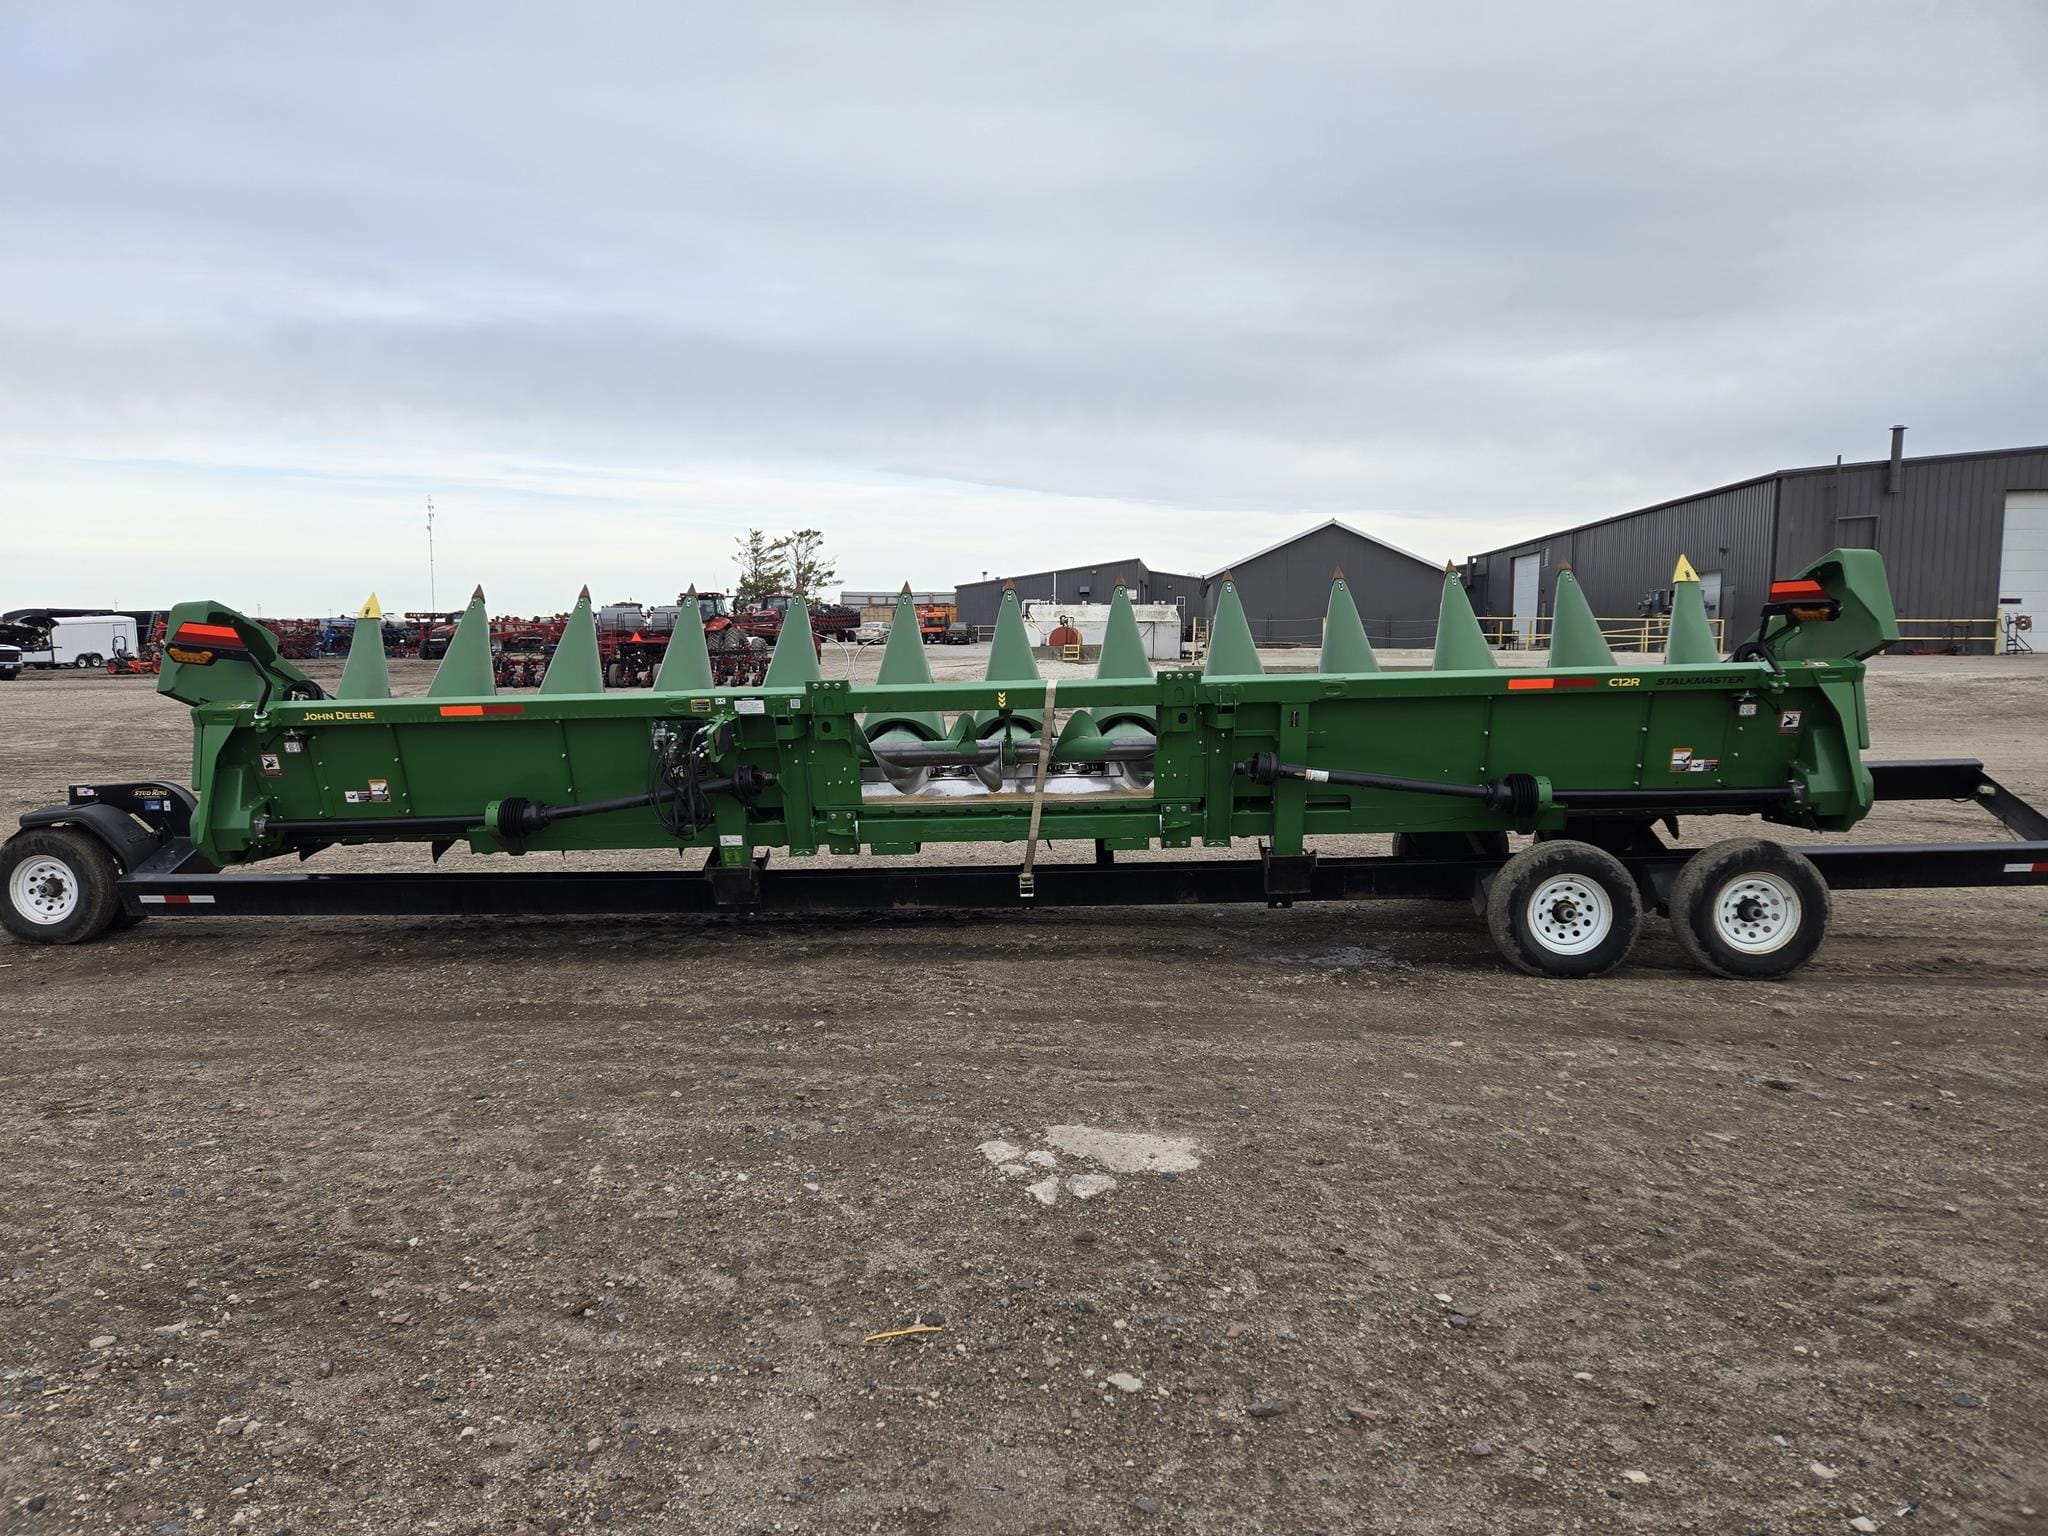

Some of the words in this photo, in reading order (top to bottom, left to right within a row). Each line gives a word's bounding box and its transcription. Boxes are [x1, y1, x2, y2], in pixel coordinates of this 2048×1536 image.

[1608, 678, 1641, 687] C12R
[1656, 676, 1745, 686] STALKMASTER
[303, 712, 335, 721] JOHN
[335, 711, 376, 720] DEERE
